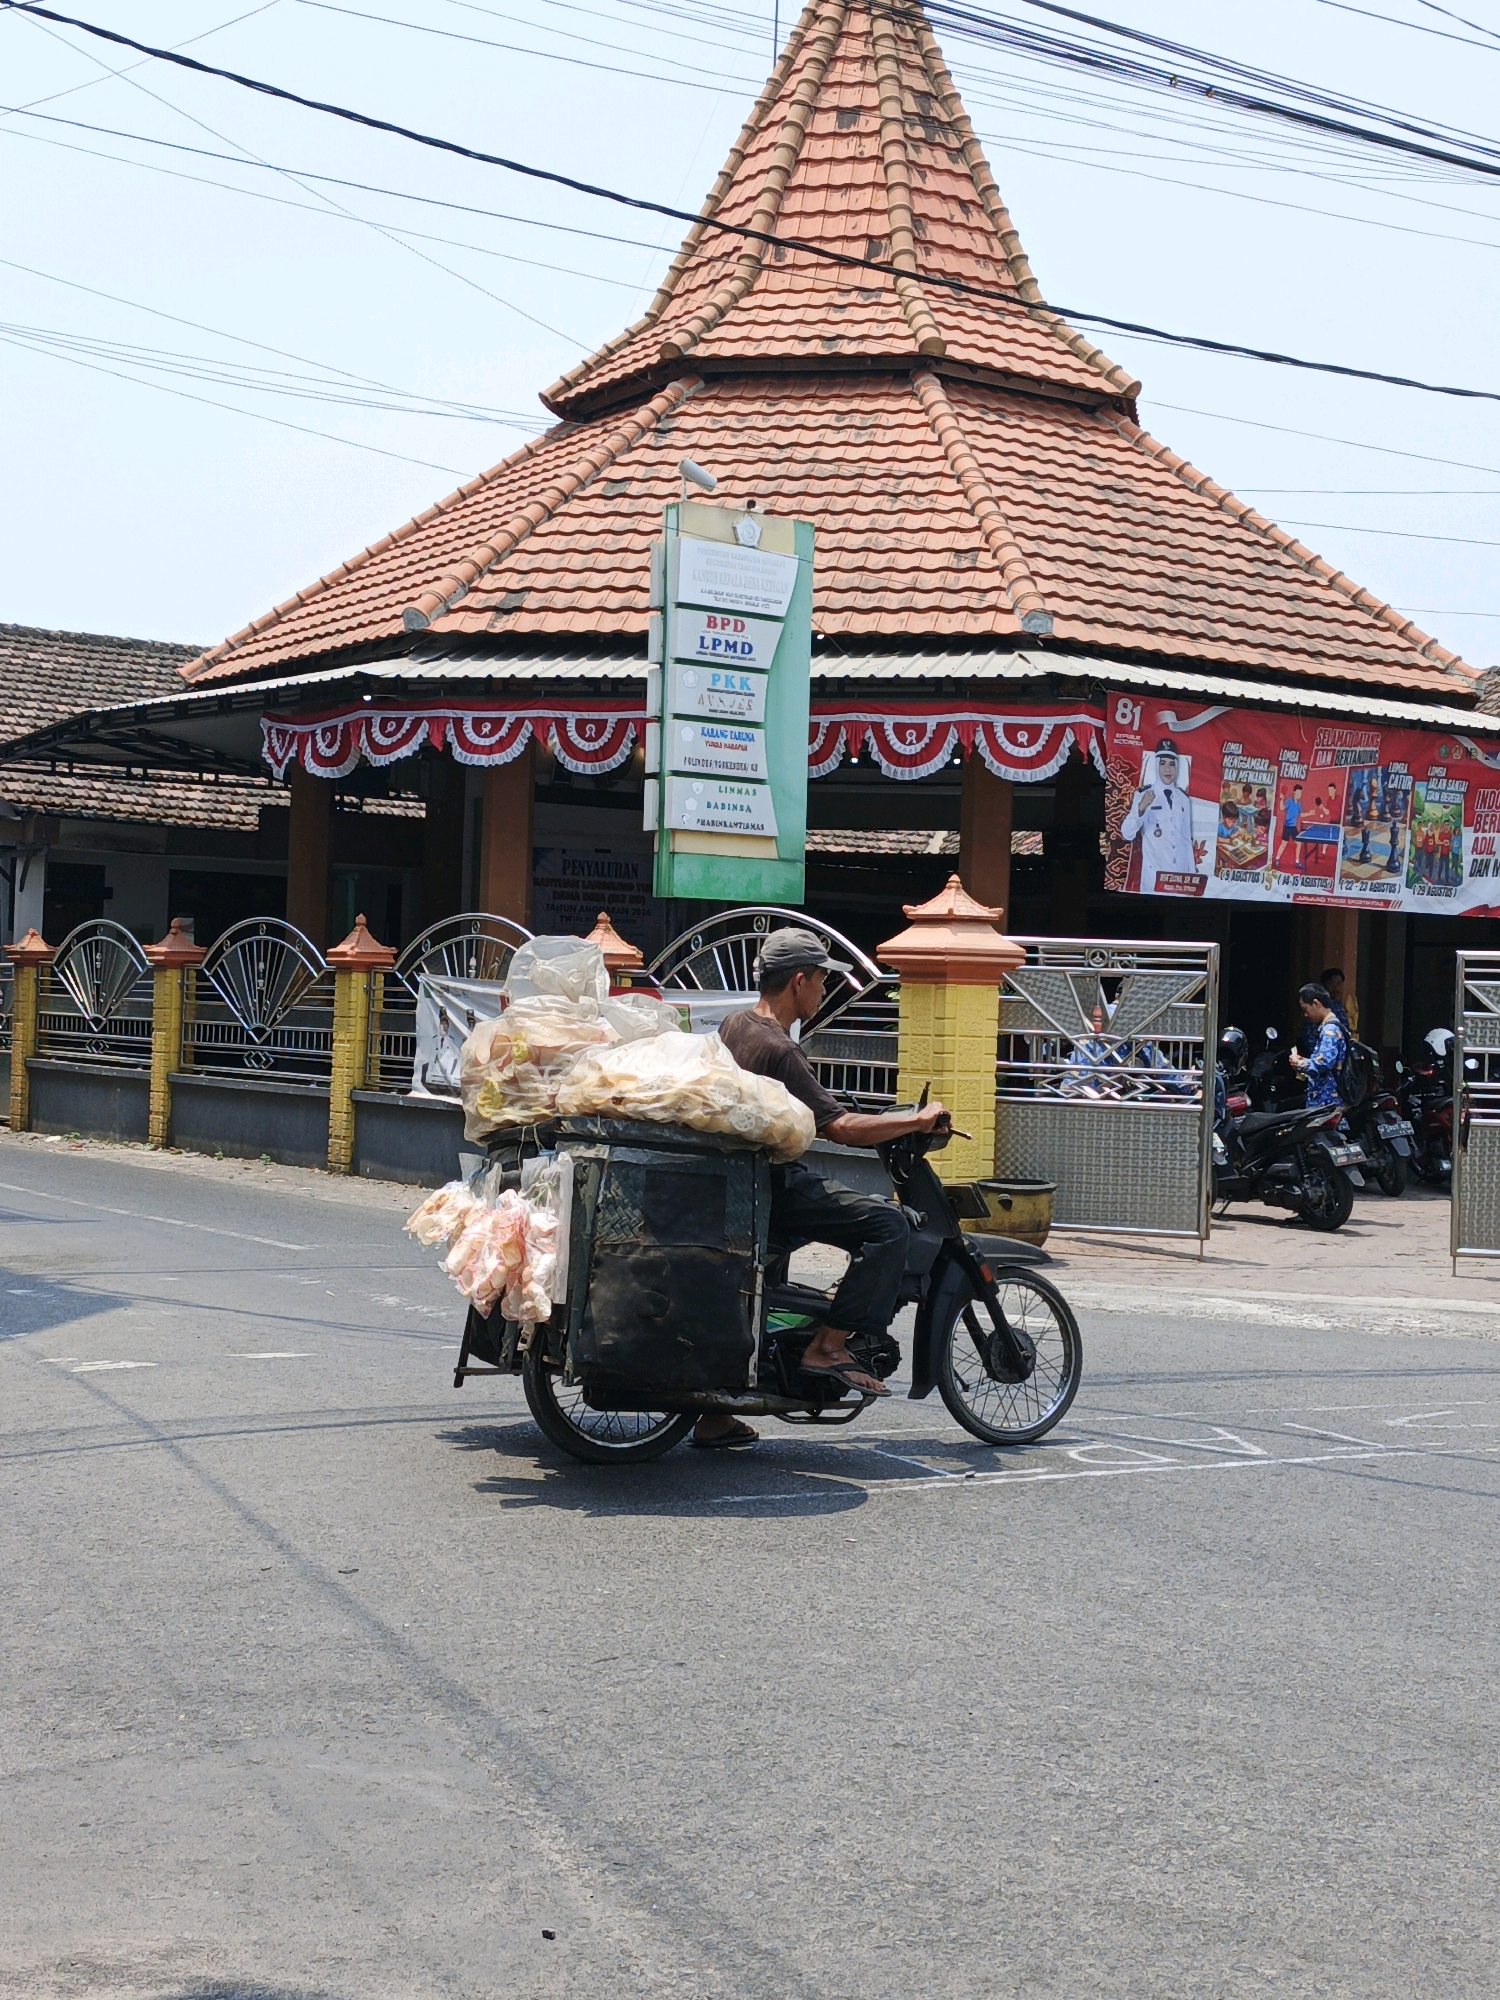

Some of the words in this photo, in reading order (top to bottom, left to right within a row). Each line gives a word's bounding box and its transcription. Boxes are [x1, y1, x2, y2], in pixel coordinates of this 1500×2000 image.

[691, 567, 718, 584] KANTOR
[706, 614, 746, 633] BPD
[699, 635, 754, 655] LPMD
[710, 672, 752, 691] PKK
[1115, 697, 1142, 731] 81
[700, 726, 728, 740] KARANG
[730, 730, 756, 742] TARUNA
[1315, 727, 1351, 748] SELAMAT
[1222, 741, 1243, 755] LOMBA
[1278, 748, 1300, 762] LOMBA
[1222, 754, 1270, 772] MENGGAMBAR
[1316, 750, 1333, 767] DAN
[1224, 768, 1239, 782] DAN
[1280, 762, 1308, 780] TENNIS
[718, 785, 758, 796] LINMAS
[1388, 774, 1414, 790] CATUR
[706, 801, 752, 814] BABINSA
[1471, 836, 1497, 857] ADIL,
[562, 858, 639, 880] PENYALURAN
[1469, 858, 1490, 878] DAN
[546, 903, 577, 913] TAHUN
[630, 908, 652, 917] 2026
